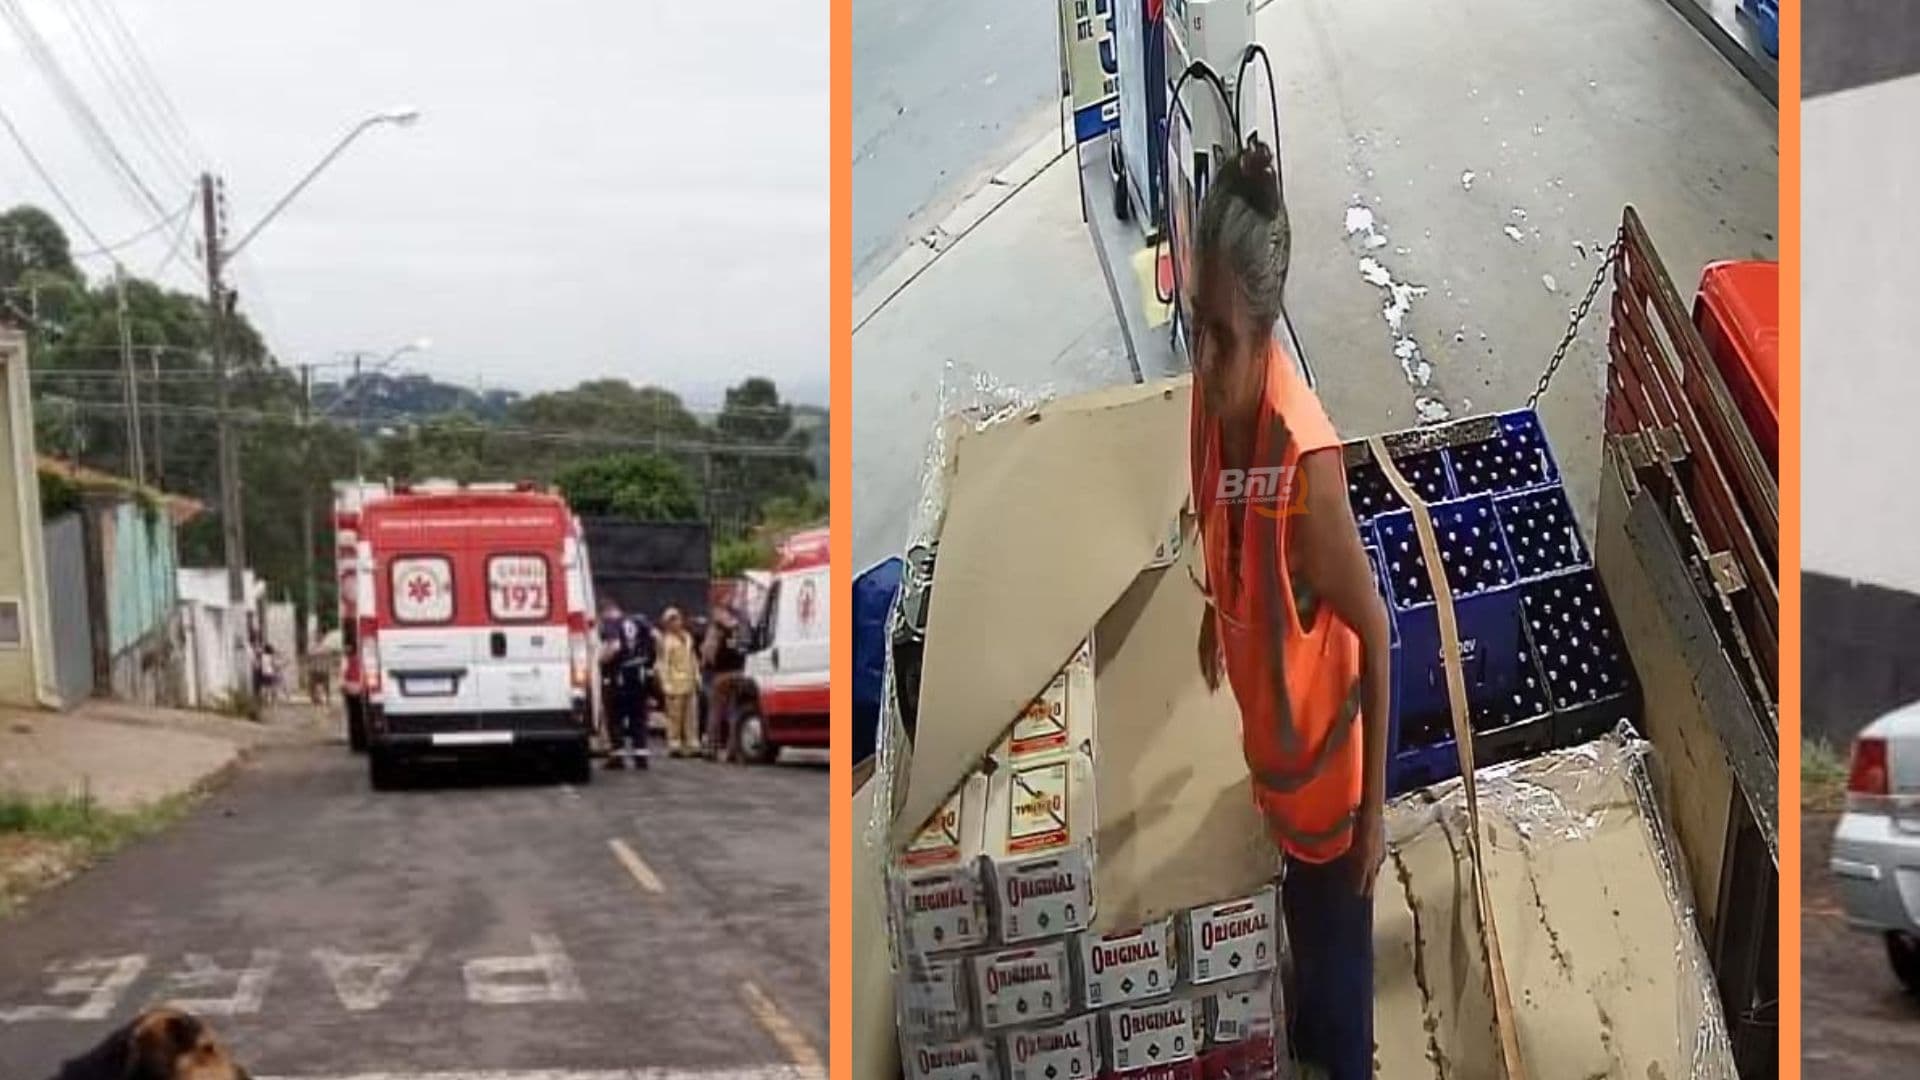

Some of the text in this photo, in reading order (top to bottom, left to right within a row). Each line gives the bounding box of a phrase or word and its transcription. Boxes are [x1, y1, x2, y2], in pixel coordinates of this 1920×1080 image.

[500, 584, 545, 610] 192
[911, 887, 968, 913] RIGINAL
[1202, 913, 1269, 951] ORIGINAL
[1092, 940, 1160, 975] ORIGINAL
[1119, 1007, 1186, 1042] ORIGINAL
